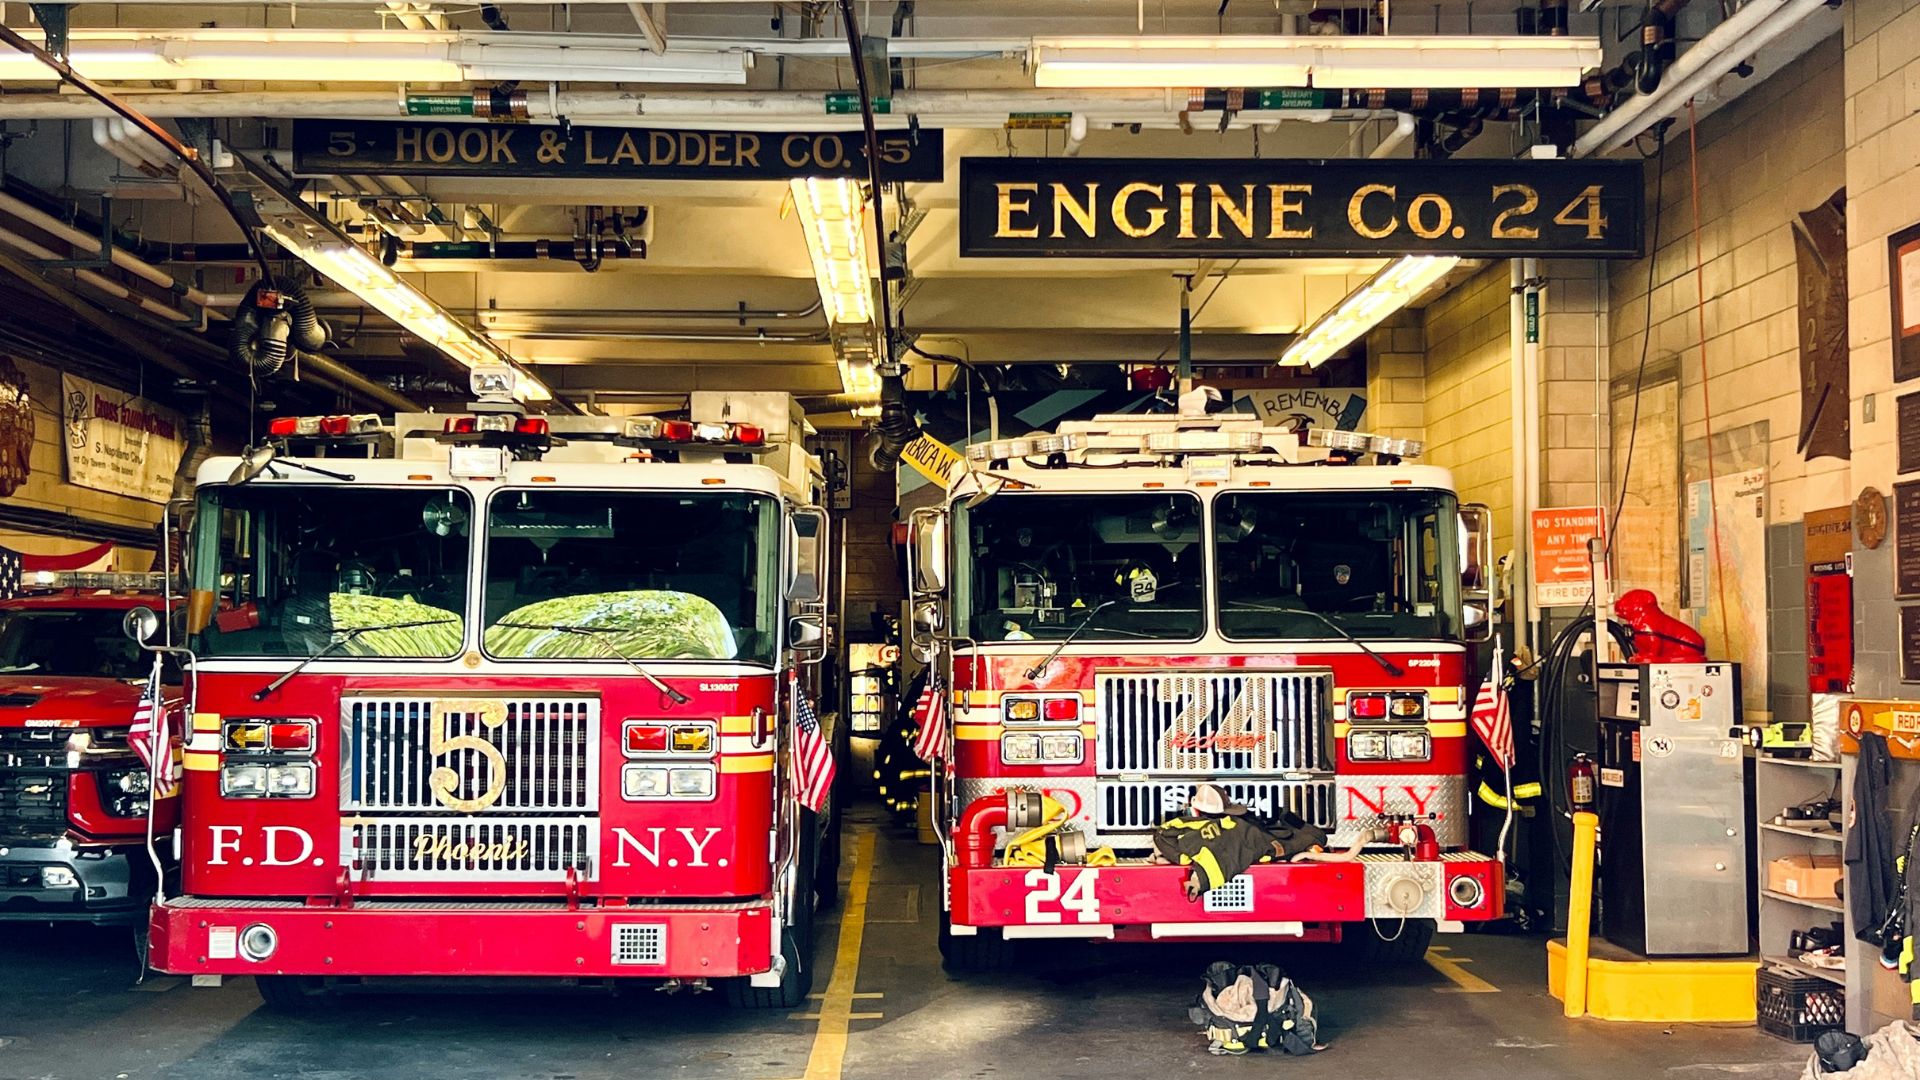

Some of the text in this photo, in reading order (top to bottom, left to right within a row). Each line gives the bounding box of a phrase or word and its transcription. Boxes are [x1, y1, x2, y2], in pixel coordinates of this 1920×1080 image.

[395, 127, 518, 164] HOOK
[536, 129, 568, 164] &
[583, 129, 760, 168] LADDER
[781, 134, 851, 169] CO.
[992, 182, 1314, 240] ENGINE
[1490, 184, 1609, 240] 24
[1536, 518, 1550, 529] NO
[1546, 534, 1566, 545] ANY
[1807, 520, 1851, 537] ENGINE 24
[1133, 582, 1155, 595] 24
[1546, 587, 1568, 597] FIRE
[1157, 676, 1277, 770] 24
[1897, 714, 1915, 729] RED
[429, 699, 509, 812] 5
[207, 825, 325, 867] F.D.
[413, 833, 529, 863] Phoenix
[611, 827, 729, 868] N.Y.
[1024, 868, 1101, 924] 24
